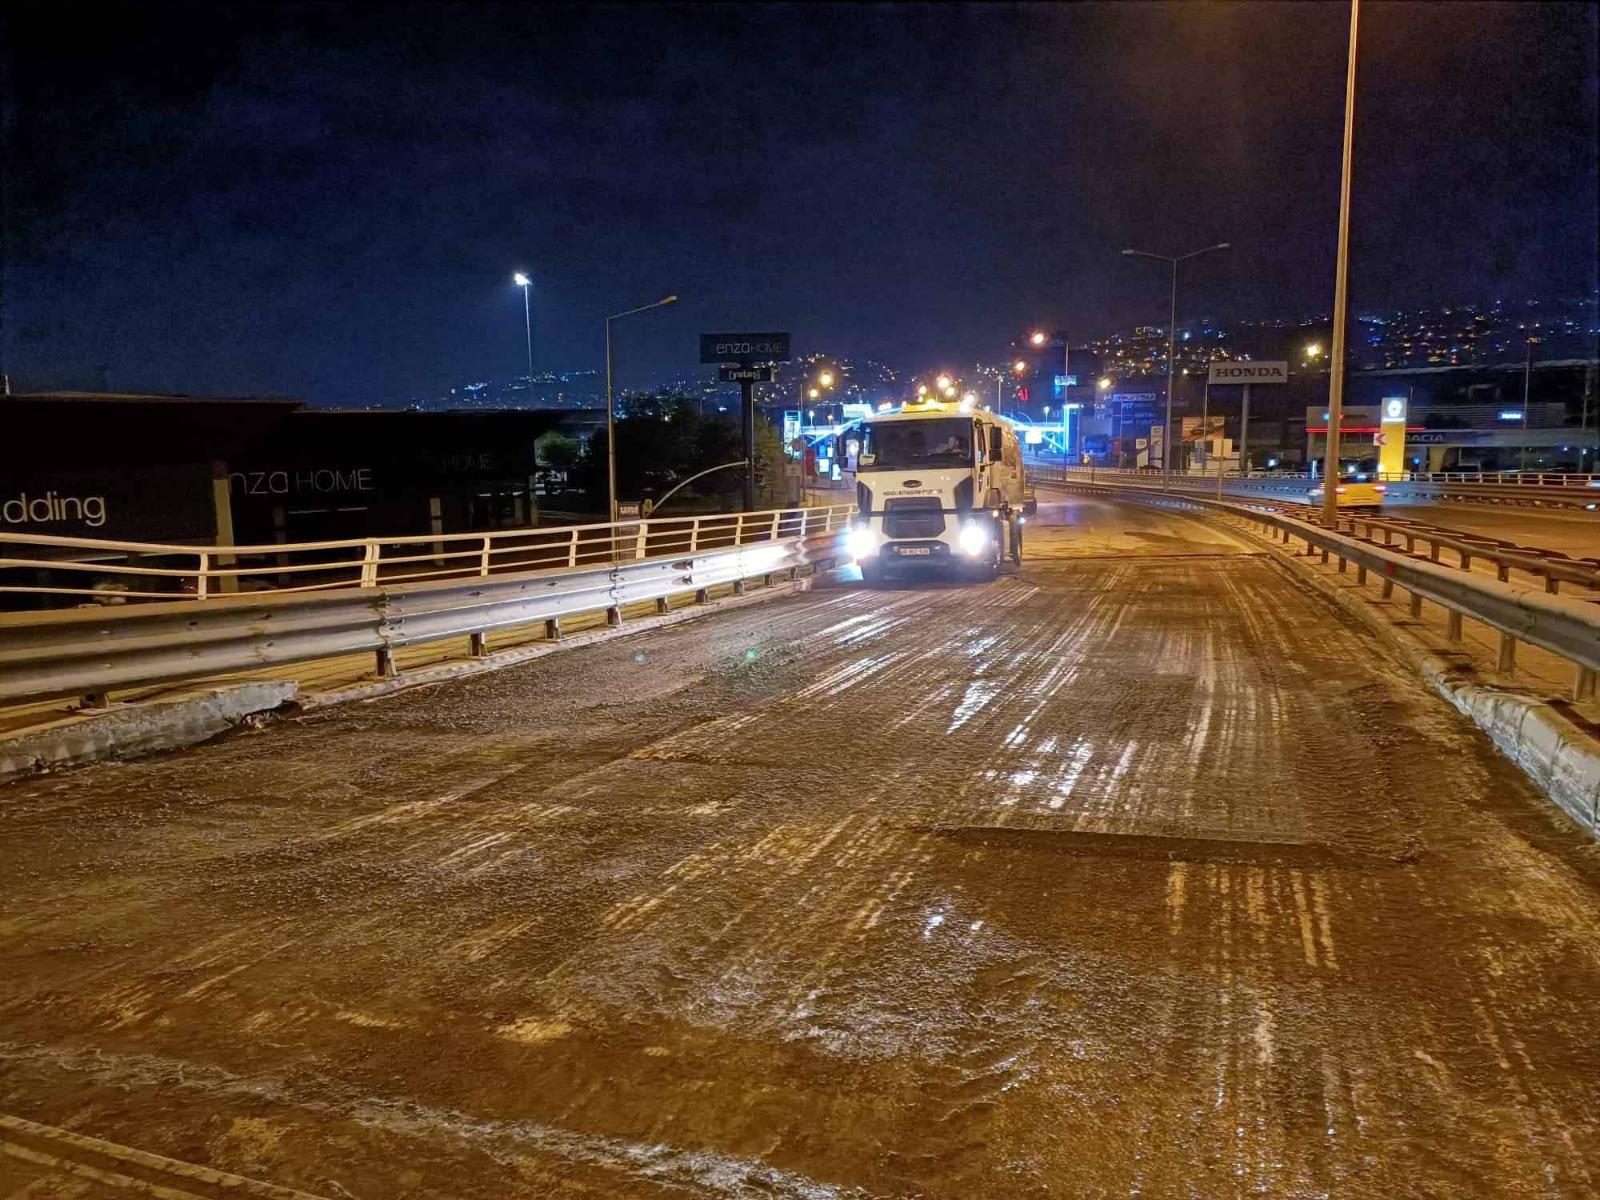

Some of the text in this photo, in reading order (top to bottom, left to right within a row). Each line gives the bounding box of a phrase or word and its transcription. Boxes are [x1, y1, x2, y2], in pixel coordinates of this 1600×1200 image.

[1215, 367, 1282, 378] HONDA
[229, 468, 375, 496] nza HOME
[0, 490, 106, 527] dding
